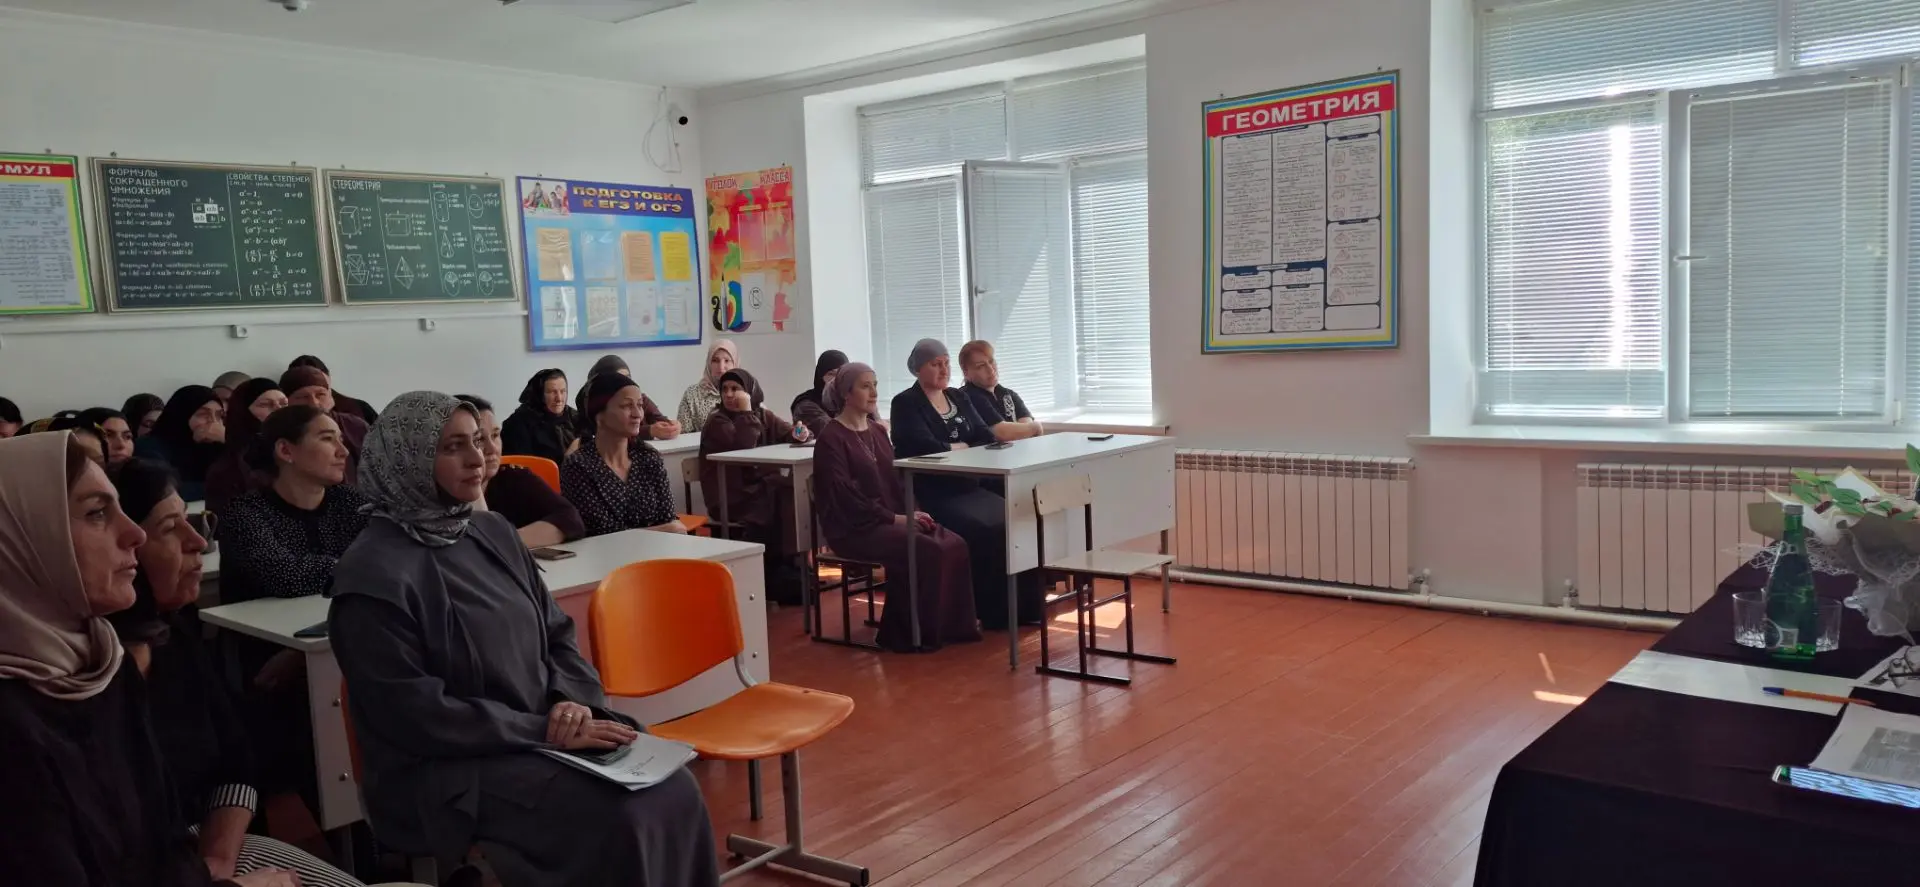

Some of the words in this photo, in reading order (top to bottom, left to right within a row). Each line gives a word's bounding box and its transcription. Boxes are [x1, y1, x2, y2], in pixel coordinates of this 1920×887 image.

[1222, 91, 1380, 131] ГЕОМЕТРИЯ
[109, 167, 158, 177] ФОРМУЛЫ
[229, 172, 269, 181] СВОЙСТВА
[272, 174, 311, 183] СТЕПЕНЕЙ
[109, 177, 188, 188] СОКРАЩЕННОГО
[332, 180, 381, 190] СТЕРЕОМЕТРИЯ
[110, 186, 171, 195] УМНОЖЕНИЯ
[573, 186, 684, 202] ПОДГОТОВКА
[583, 199, 594, 208] К
[599, 200, 630, 210] ЕГЭ
[635, 201, 646, 211] И
[650, 202, 682, 213] ОГЭ
